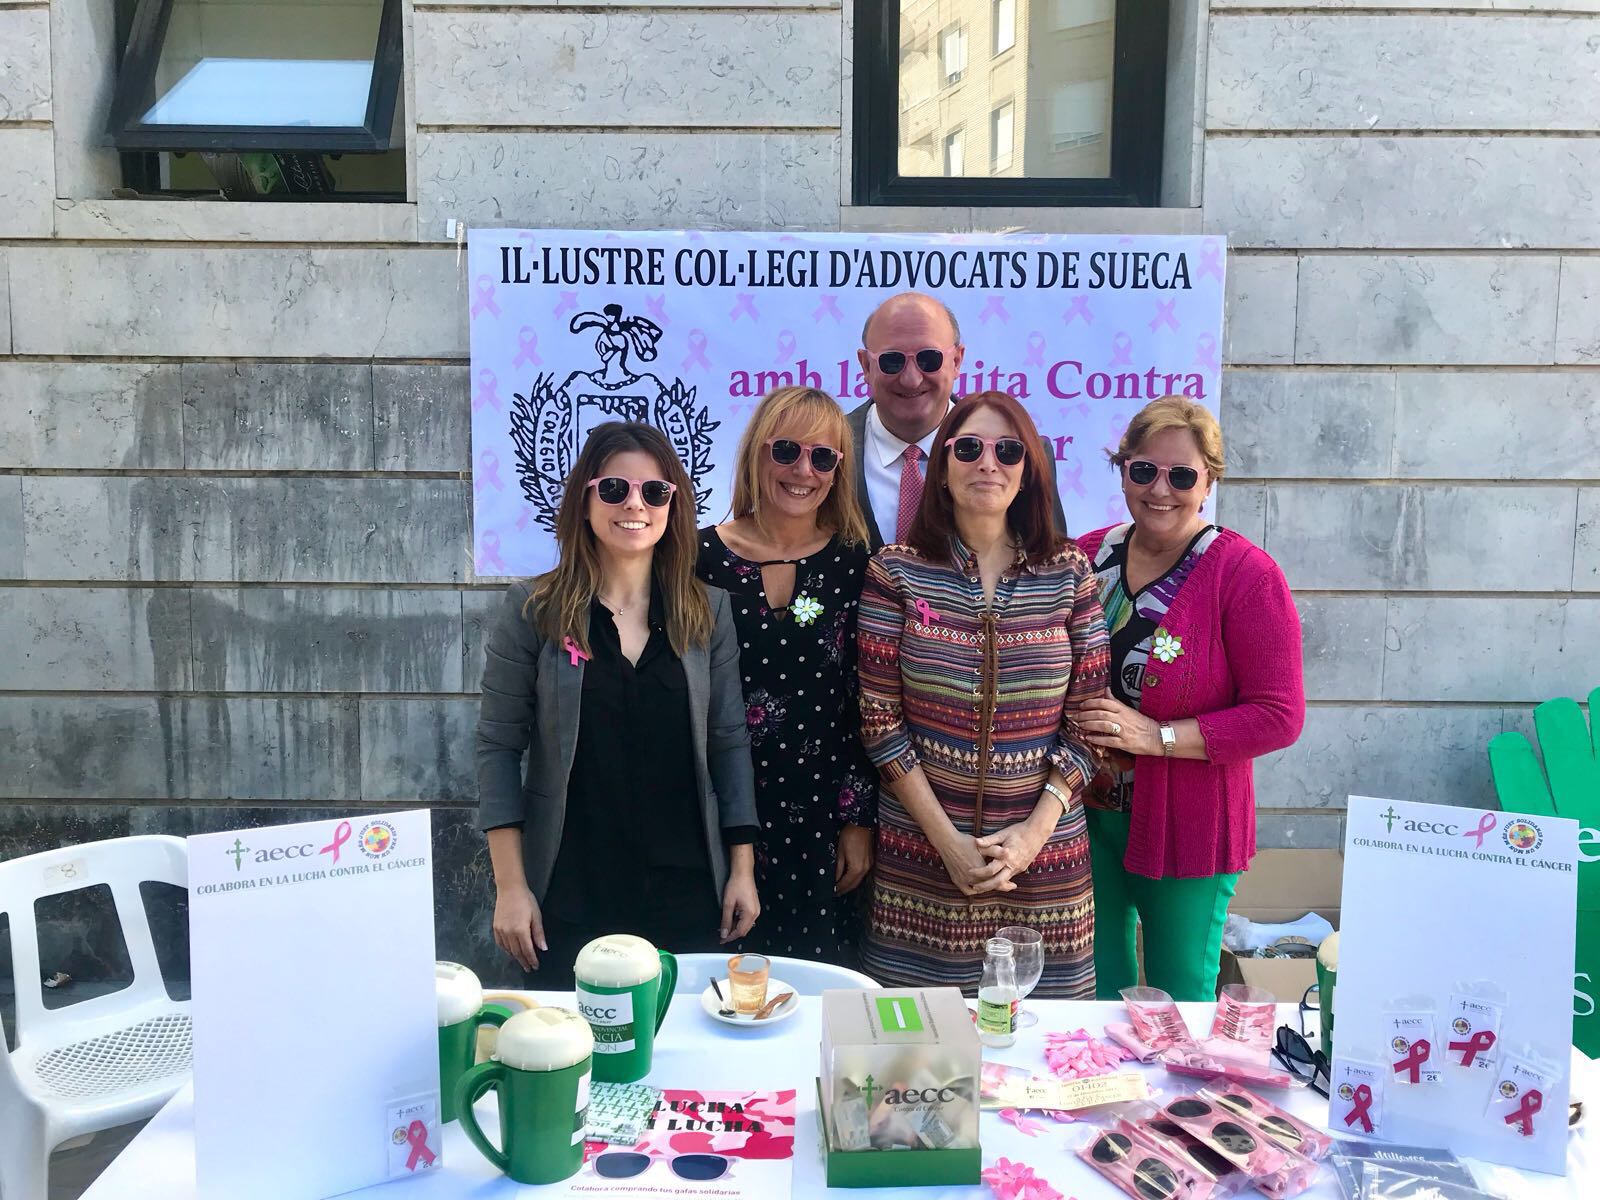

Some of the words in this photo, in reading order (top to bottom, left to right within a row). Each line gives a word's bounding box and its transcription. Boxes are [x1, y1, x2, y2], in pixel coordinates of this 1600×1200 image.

[500, 246, 665, 285] IL·LUSTRE
[674, 248, 819, 288] COL·LEGI
[828, 248, 1027, 289] D'ADVOCATS
[1036, 251, 1080, 289] DE
[1088, 251, 1192, 290] SUECA
[1046, 360, 1207, 399] Contra
[1403, 819, 1460, 836] aecc
[254, 843, 314, 863] aecc
[1352, 837, 1404, 851] COLABORA
[1406, 843, 1419, 853] EN
[1421, 846, 1434, 855] LA
[1436, 847, 1469, 859] LUCHA
[1471, 852, 1513, 865] CONTRA
[1515, 857, 1529, 867] EL
[1530, 858, 1573, 872] CÁNCER
[196, 879, 257, 895] COLABORA
[259, 877, 274, 887] EN
[276, 874, 290, 885] LA
[292, 870, 327, 883] LUCHA
[329, 864, 371, 877] CONTRA
[372, 862, 386, 873] EL
[387, 857, 426, 870] CÁNCER
[578, 1001, 617, 1020] aecc
[884, 1086, 955, 1105] aecc
[653, 1100, 744, 1114] LUCHA
[667, 1119, 763, 1132] LUCHA
